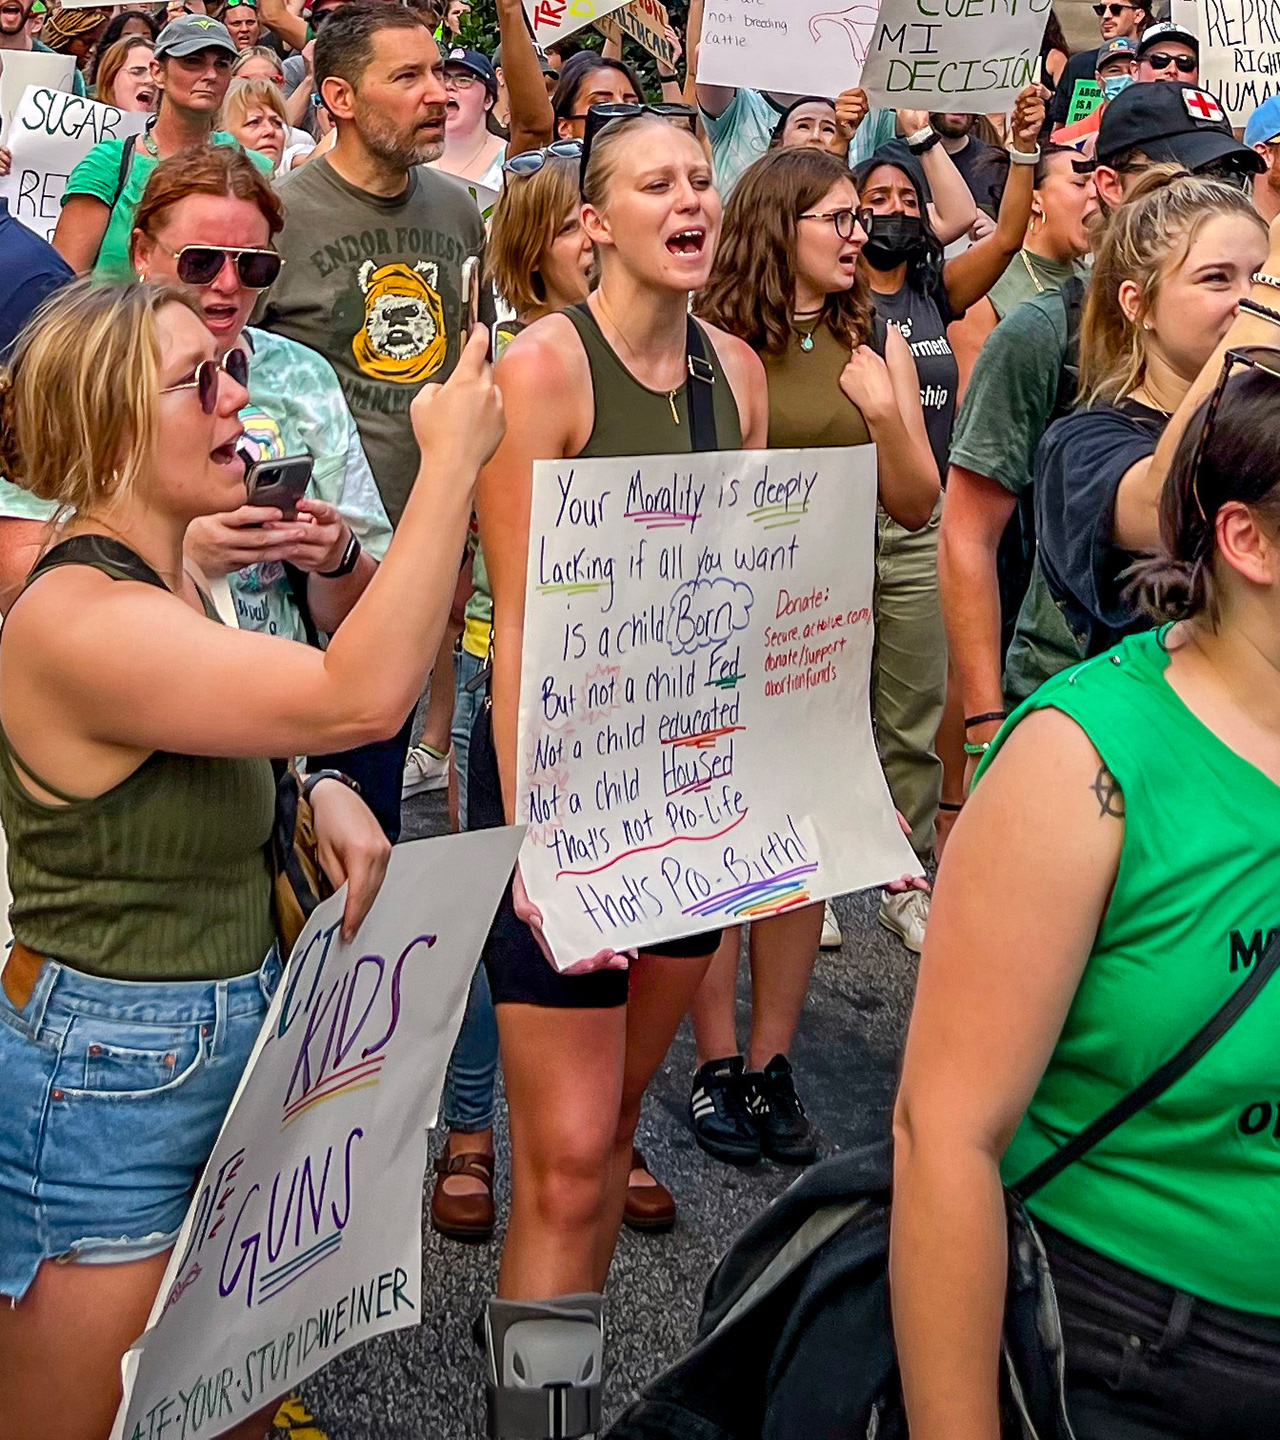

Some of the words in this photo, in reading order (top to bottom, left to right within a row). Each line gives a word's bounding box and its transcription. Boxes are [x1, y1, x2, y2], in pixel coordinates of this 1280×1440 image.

[708, 10, 734, 25] not
[743, 13, 789, 35] breeding
[877, 22, 943, 55] MI
[886, 49, 1040, 93] DECISIÓN
[21, 88, 122, 145] SUGAR
[310, 228, 392, 279] ENDOR
[395, 226, 464, 265] FOREST
[555, 468, 611, 529] Your
[626, 468, 706, 535] Morality
[717, 471, 740, 509] is
[753, 465, 819, 513] deeply
[539, 535, 617, 613] Lacking
[629, 538, 648, 581] if
[659, 543, 684, 582] all
[692, 545, 723, 597] you
[734, 534, 800, 573] want
[776, 586, 830, 619] Donate:
[598, 624, 611, 659] a
[616, 604, 665, 655] child
[675, 593, 734, 646] Born
[540, 674, 577, 722] But
[587, 681, 617, 710] not
[624, 682, 635, 704] a
[645, 659, 696, 703] child
[709, 641, 741, 679] Fed
[533, 734, 565, 774] Not
[572, 741, 583, 760] a
[596, 713, 646, 755] child
[658, 690, 741, 743] educated
[528, 783, 560, 825] Not
[569, 792, 583, 814] a
[595, 767, 640, 811] child
[661, 738, 734, 797] Housed
[546, 827, 610, 870] that's
[622, 809, 654, 847] not
[283, 933, 438, 1108] KIDS
[218, 1127, 364, 1308] GUNS
